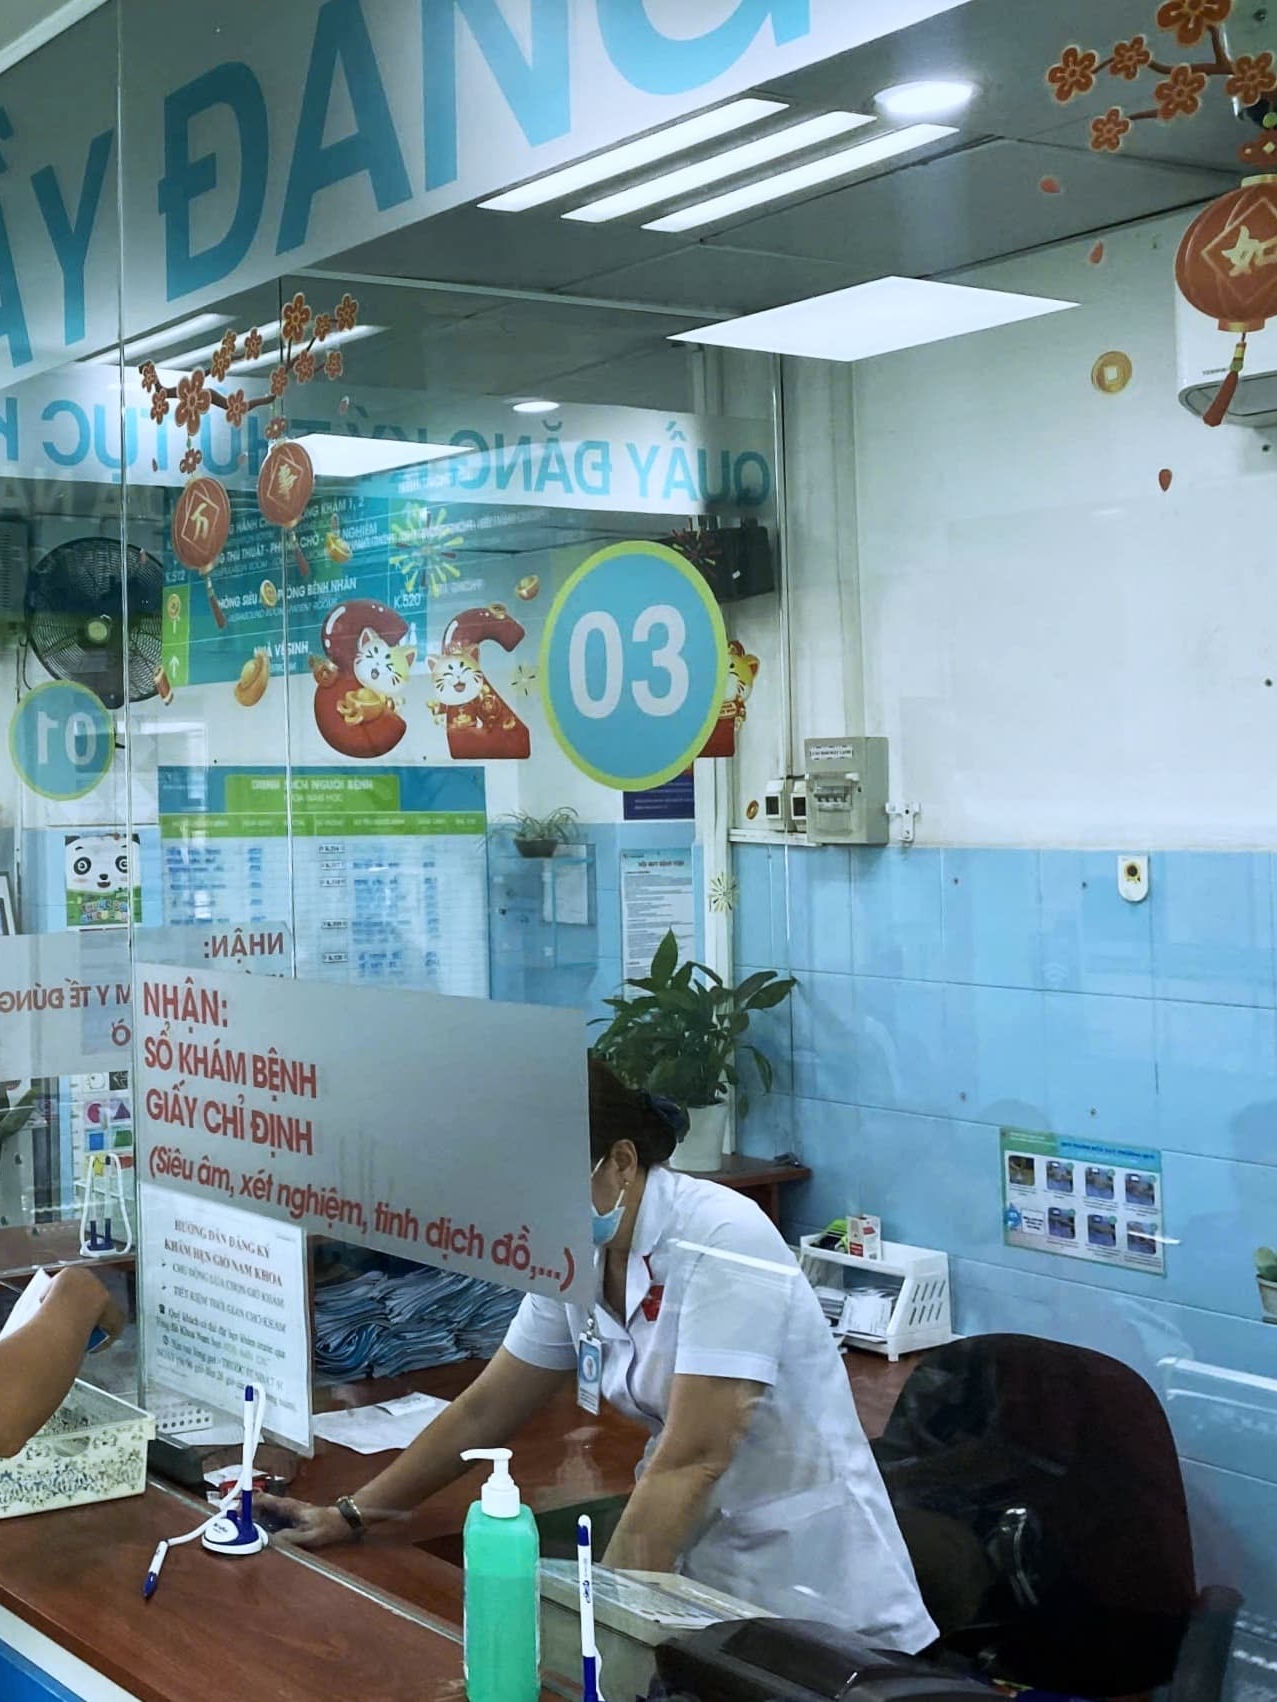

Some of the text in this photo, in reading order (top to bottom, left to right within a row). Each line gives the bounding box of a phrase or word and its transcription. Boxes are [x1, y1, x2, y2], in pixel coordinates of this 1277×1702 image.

[218, 595, 241, 609] HÒNG
[393, 593, 422, 609] K.520
[286, 641, 309, 657] SINH
[569, 604, 691, 720] 03
[143, 976, 228, 1034] NHẬN:
[144, 1020, 317, 1103] SỔ KHÁM BỆNH
[146, 1079, 314, 1159] GIẤY CHỈ ĐỊNH
[149, 1145, 194, 1180] (Siêu
[197, 1155, 235, 1198] âm,
[239, 1168, 273, 1202] xét
[277, 1183, 368, 1235] nghiệm,
[374, 1200, 419, 1242] tinh
[425, 1216, 485, 1261] dịch
